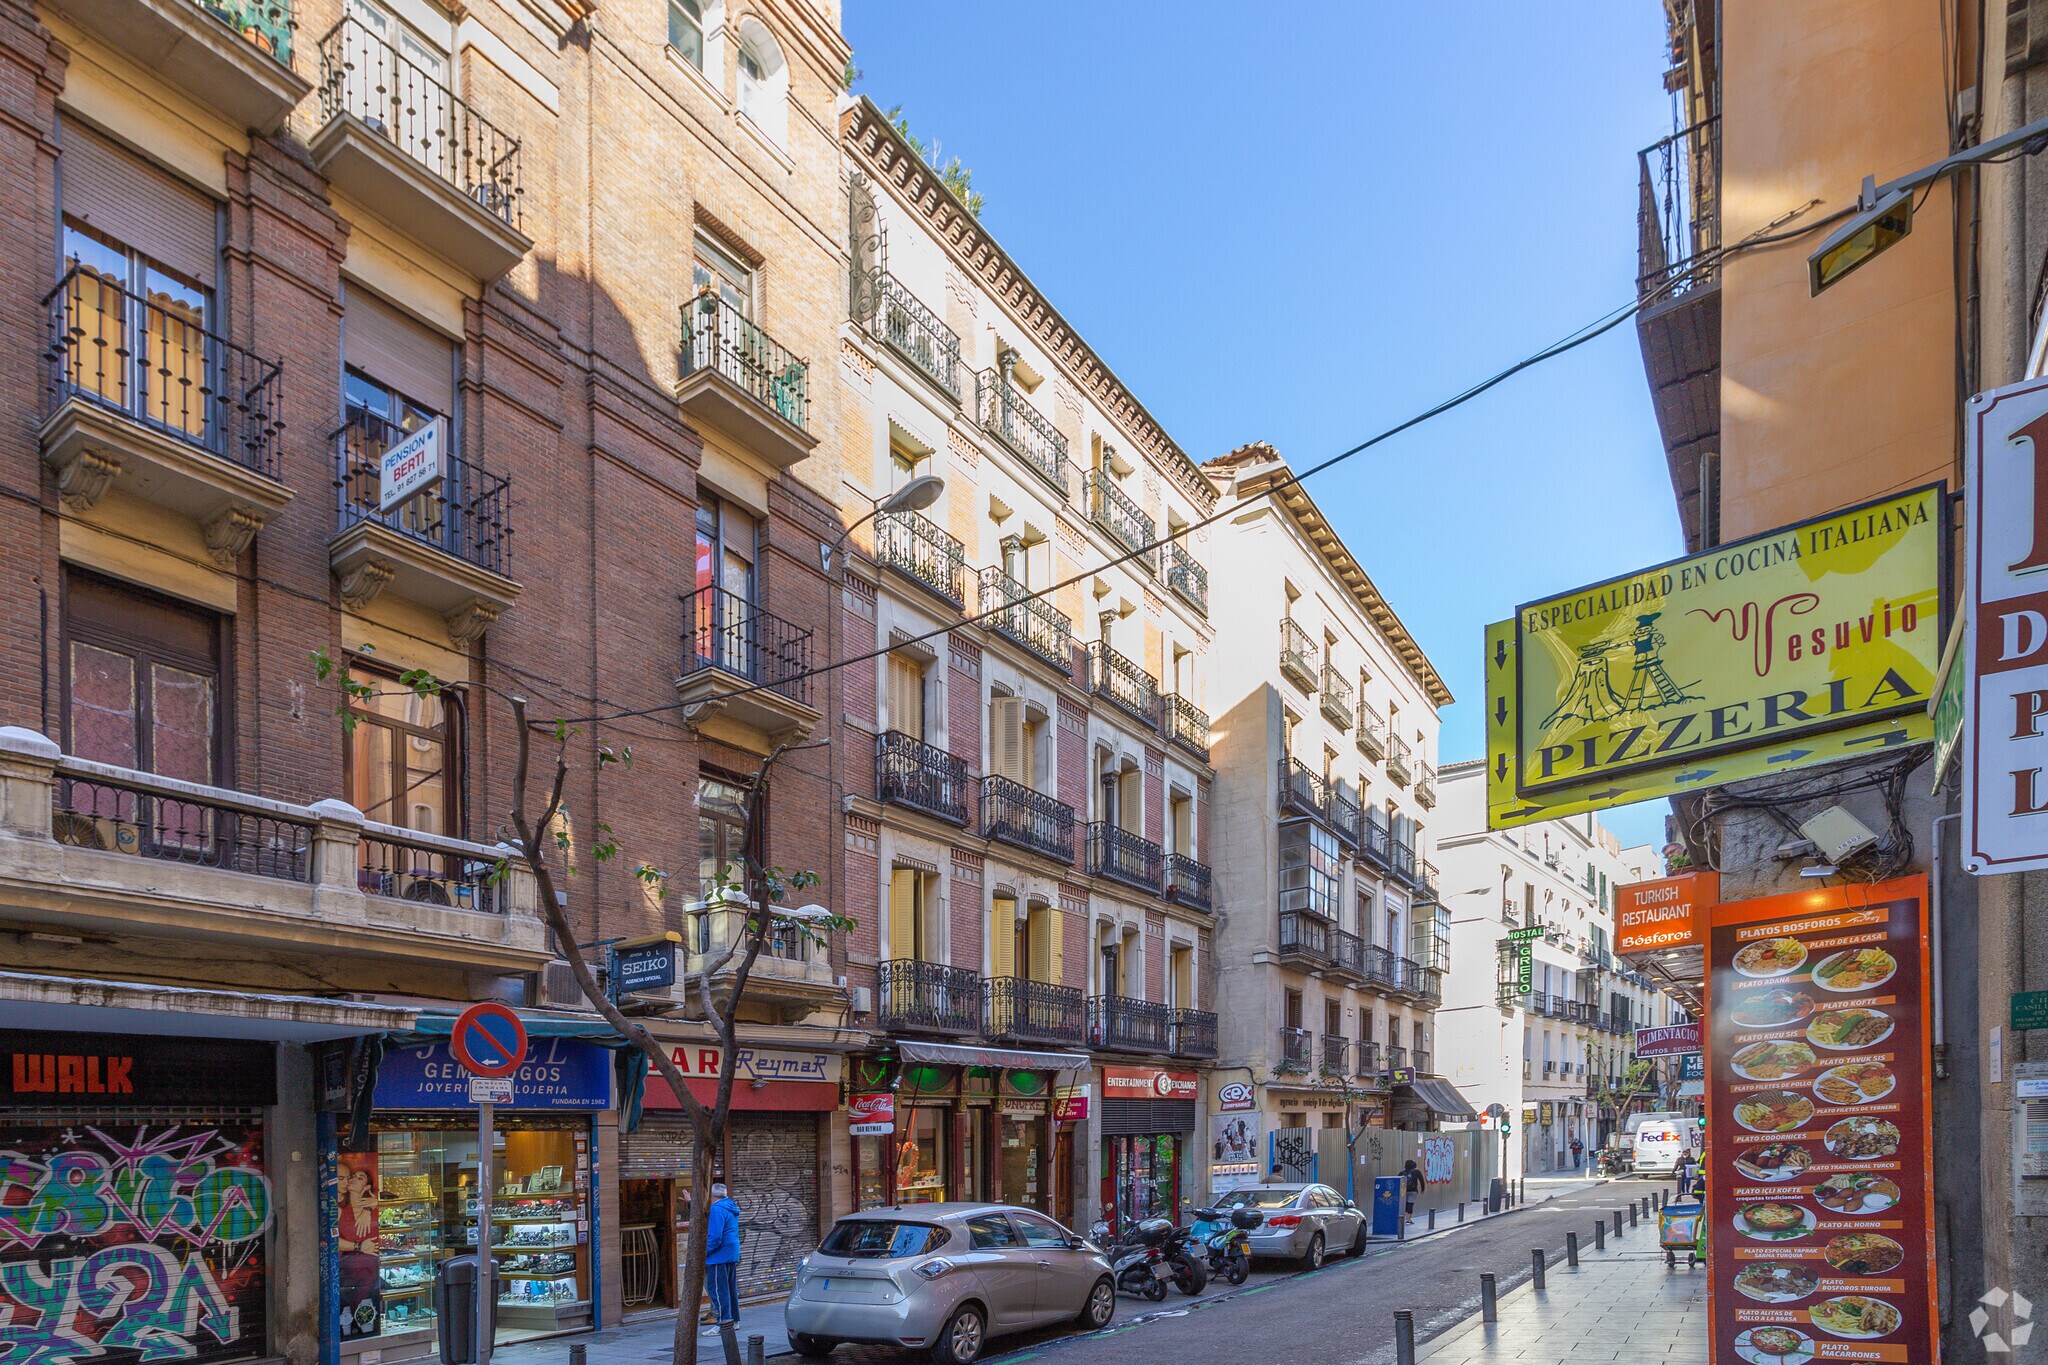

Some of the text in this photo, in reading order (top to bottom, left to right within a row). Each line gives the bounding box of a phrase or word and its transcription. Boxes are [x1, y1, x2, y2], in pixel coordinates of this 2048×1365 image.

[394, 449, 425, 482] BERTI
[397, 482, 404, 492] 91
[1528, 498, 1930, 635] ESPECIALIDAD EN COCINA ITALIANA
[1998, 609, 2047, 662] D
[1535, 666, 1924, 780] PIZZERIA
[1634, 885, 1679, 905] TURKISH
[1622, 903, 1691, 926] RESTAURANT
[1507, 927, 1543, 940] HOSTAL
[1740, 925, 1780, 939] PLATOS
[1782, 917, 1841, 933] BOSFOROS
[1622, 930, 1692, 947] Bósforos
[1810, 940, 1835, 948] PLATO
[1861, 933, 1882, 942] CASA
[622, 957, 668, 975] SEIKO
[1519, 947, 1531, 992] GRECO
[645, 974, 661, 982] OFICIAL
[1738, 977, 1790, 988] PLATO ADANA
[1823, 998, 1878, 1009] PLATO KOFTE
[1640, 1044, 1697, 1056] FRUTOS SECOS
[12, 1053, 134, 1094] WALK
[1687, 1062, 1704, 1070] ME
[1107, 1077, 1154, 1088] ENTERTAINMENT
[1171, 1080, 1197, 1090] EXCHANGE
[1641, 1131, 1681, 1142] FedEx
[1760, 1133, 1807, 1141] CODORNICES
[1821, 1350, 1881, 1359] MACARRONES
